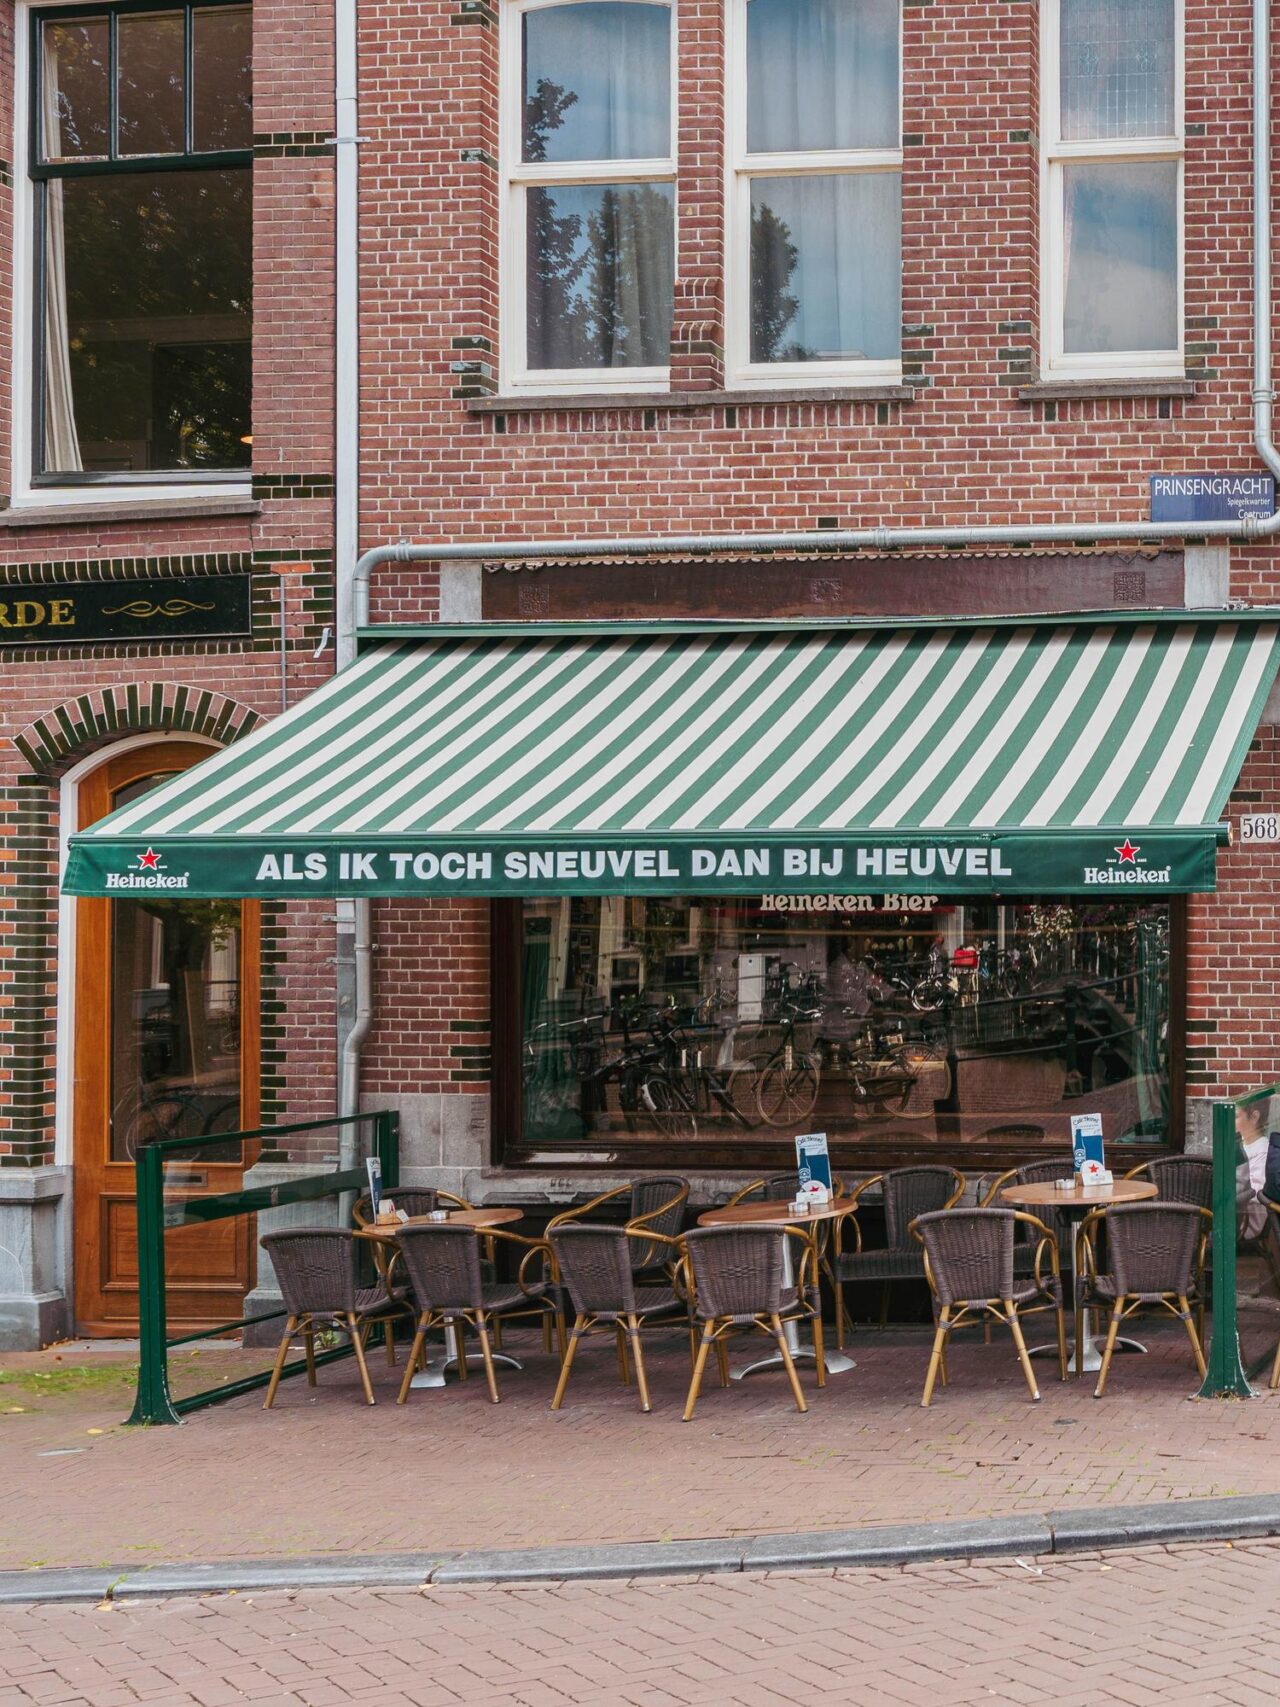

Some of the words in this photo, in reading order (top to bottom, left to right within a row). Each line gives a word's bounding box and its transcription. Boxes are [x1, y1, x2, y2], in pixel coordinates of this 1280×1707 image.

[1155, 478, 1271, 496] PRINSENGRACHT
[1227, 497, 1271, 507] Spiegelkwartier
[1243, 817, 1277, 839] 568
[255, 853, 327, 880] ALS
[339, 853, 378, 880] IK
[390, 852, 492, 880] TOCH
[504, 850, 680, 880] SNEUVEL
[691, 849, 770, 877] DAN
[783, 848, 843, 877] BIJ
[857, 848, 1012, 876] HEUVEL
[105, 873, 189, 888] Heineken
[1084, 867, 1170, 884] Heineken
[760, 894, 875, 912] Heineken
[881, 893, 939, 912] Bier
